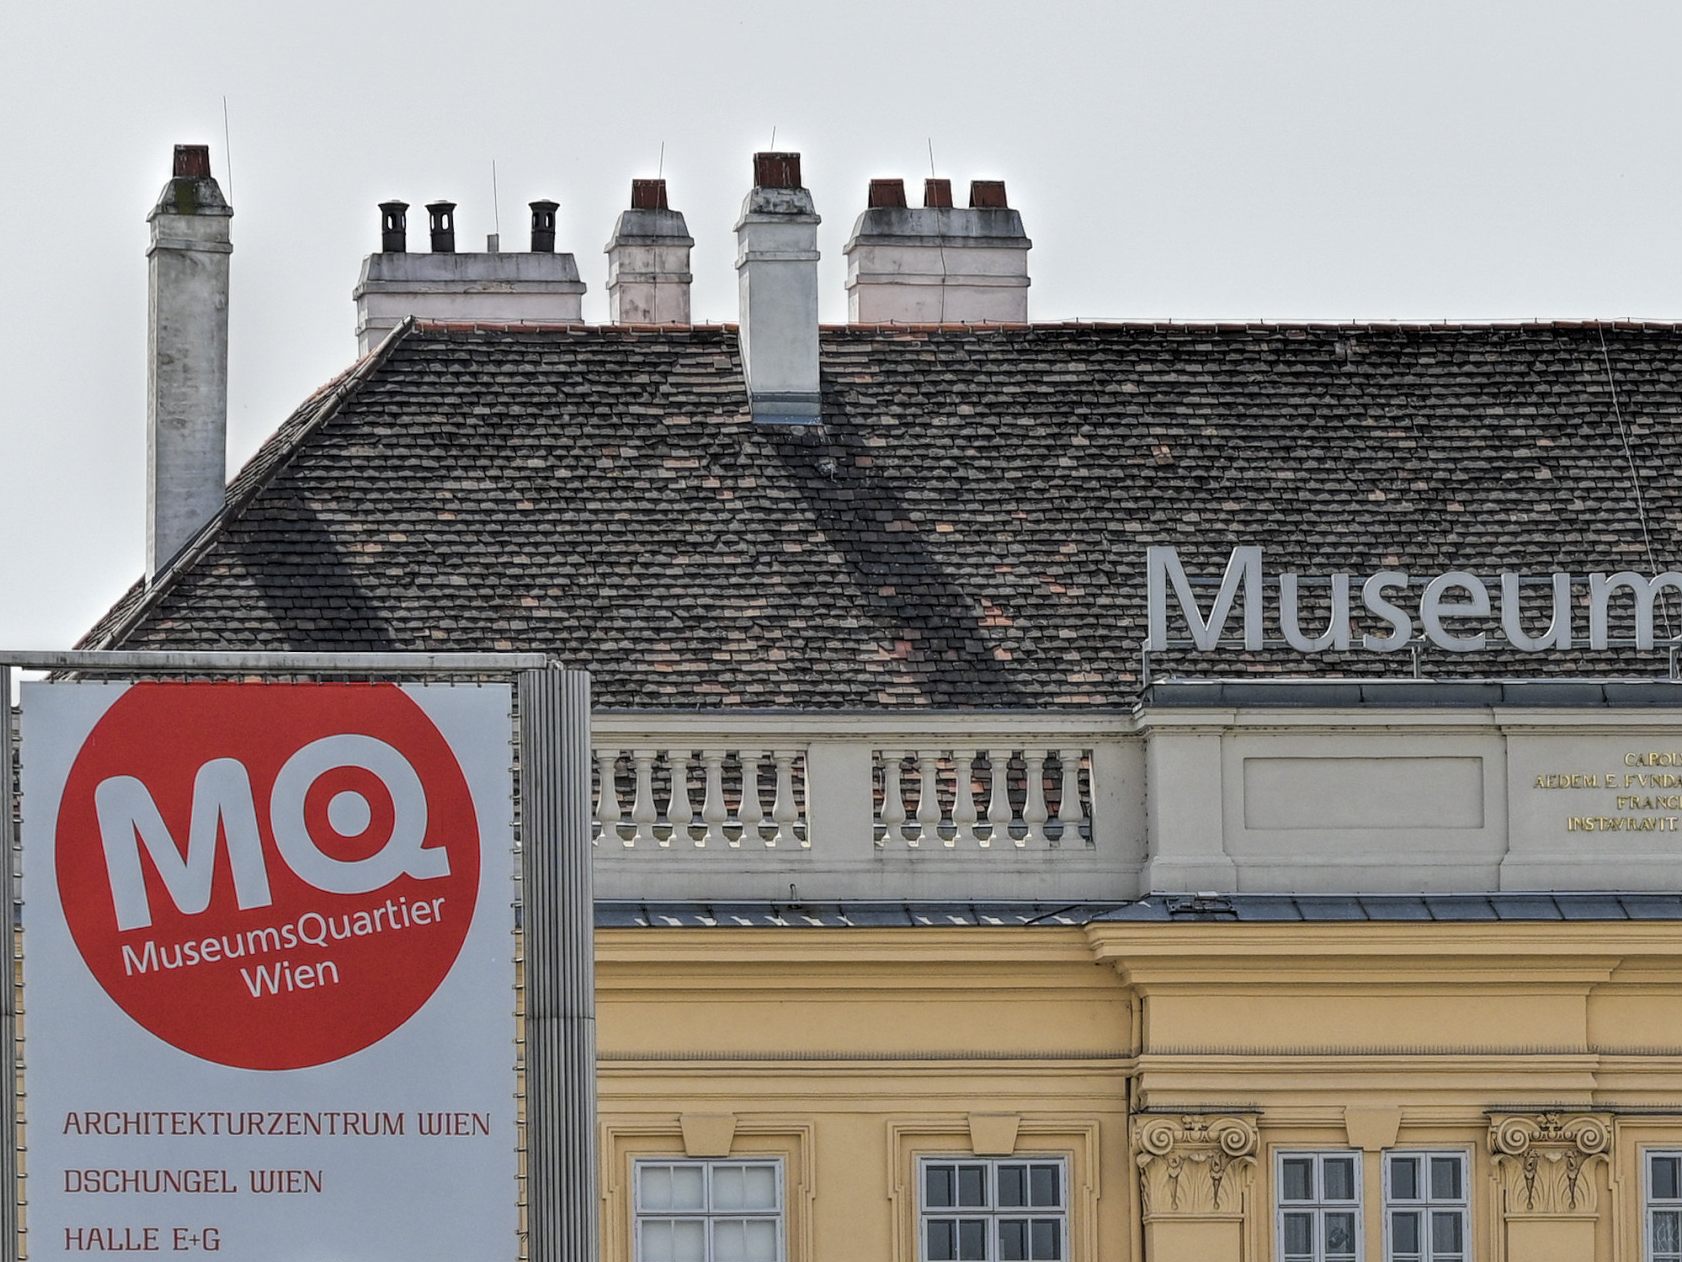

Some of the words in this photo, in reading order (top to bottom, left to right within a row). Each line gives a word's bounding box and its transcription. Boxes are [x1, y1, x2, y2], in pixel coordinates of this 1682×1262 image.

[94, 733, 452, 932] MQ
[120, 896, 446, 977] MuseumsQuartier
[239, 959, 340, 999] Wien
[62, 1111, 405, 1137] ARCHITEKTURZENTRUM
[416, 1111, 491, 1136] WIEN
[63, 1169, 238, 1194] DSCHUNGEL
[249, 1169, 324, 1194] WIEN
[63, 1227, 160, 1252] HALLE
[172, 1227, 221, 1252] E+G
